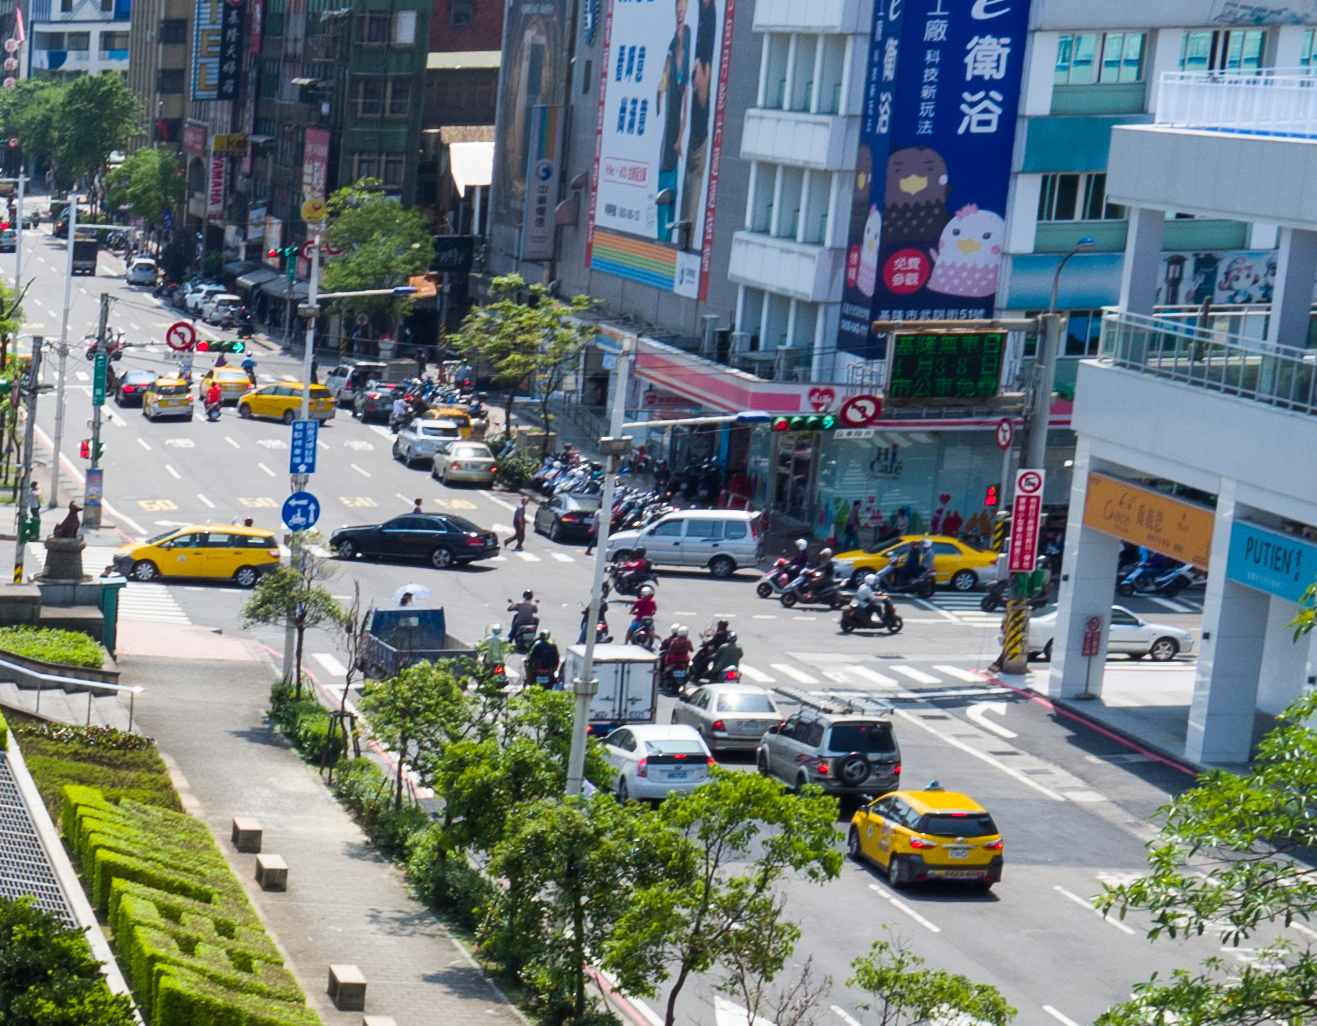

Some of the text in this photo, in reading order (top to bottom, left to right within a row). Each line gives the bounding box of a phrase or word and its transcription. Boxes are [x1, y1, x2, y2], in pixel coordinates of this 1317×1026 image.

[916, 49, 941, 135] 科技新玩法
[957, 34, 1012, 135] 衛浴
[210, 156, 225, 206] YAMAHA
[534, 184, 549, 228] 中華電信
[893, 256, 922, 271] 免費
[896, 334, 1002, 356] 基隆無車日
[891, 377, 998, 398] 市公車免費
[1245, 536, 1293, 575] PUTIEN
